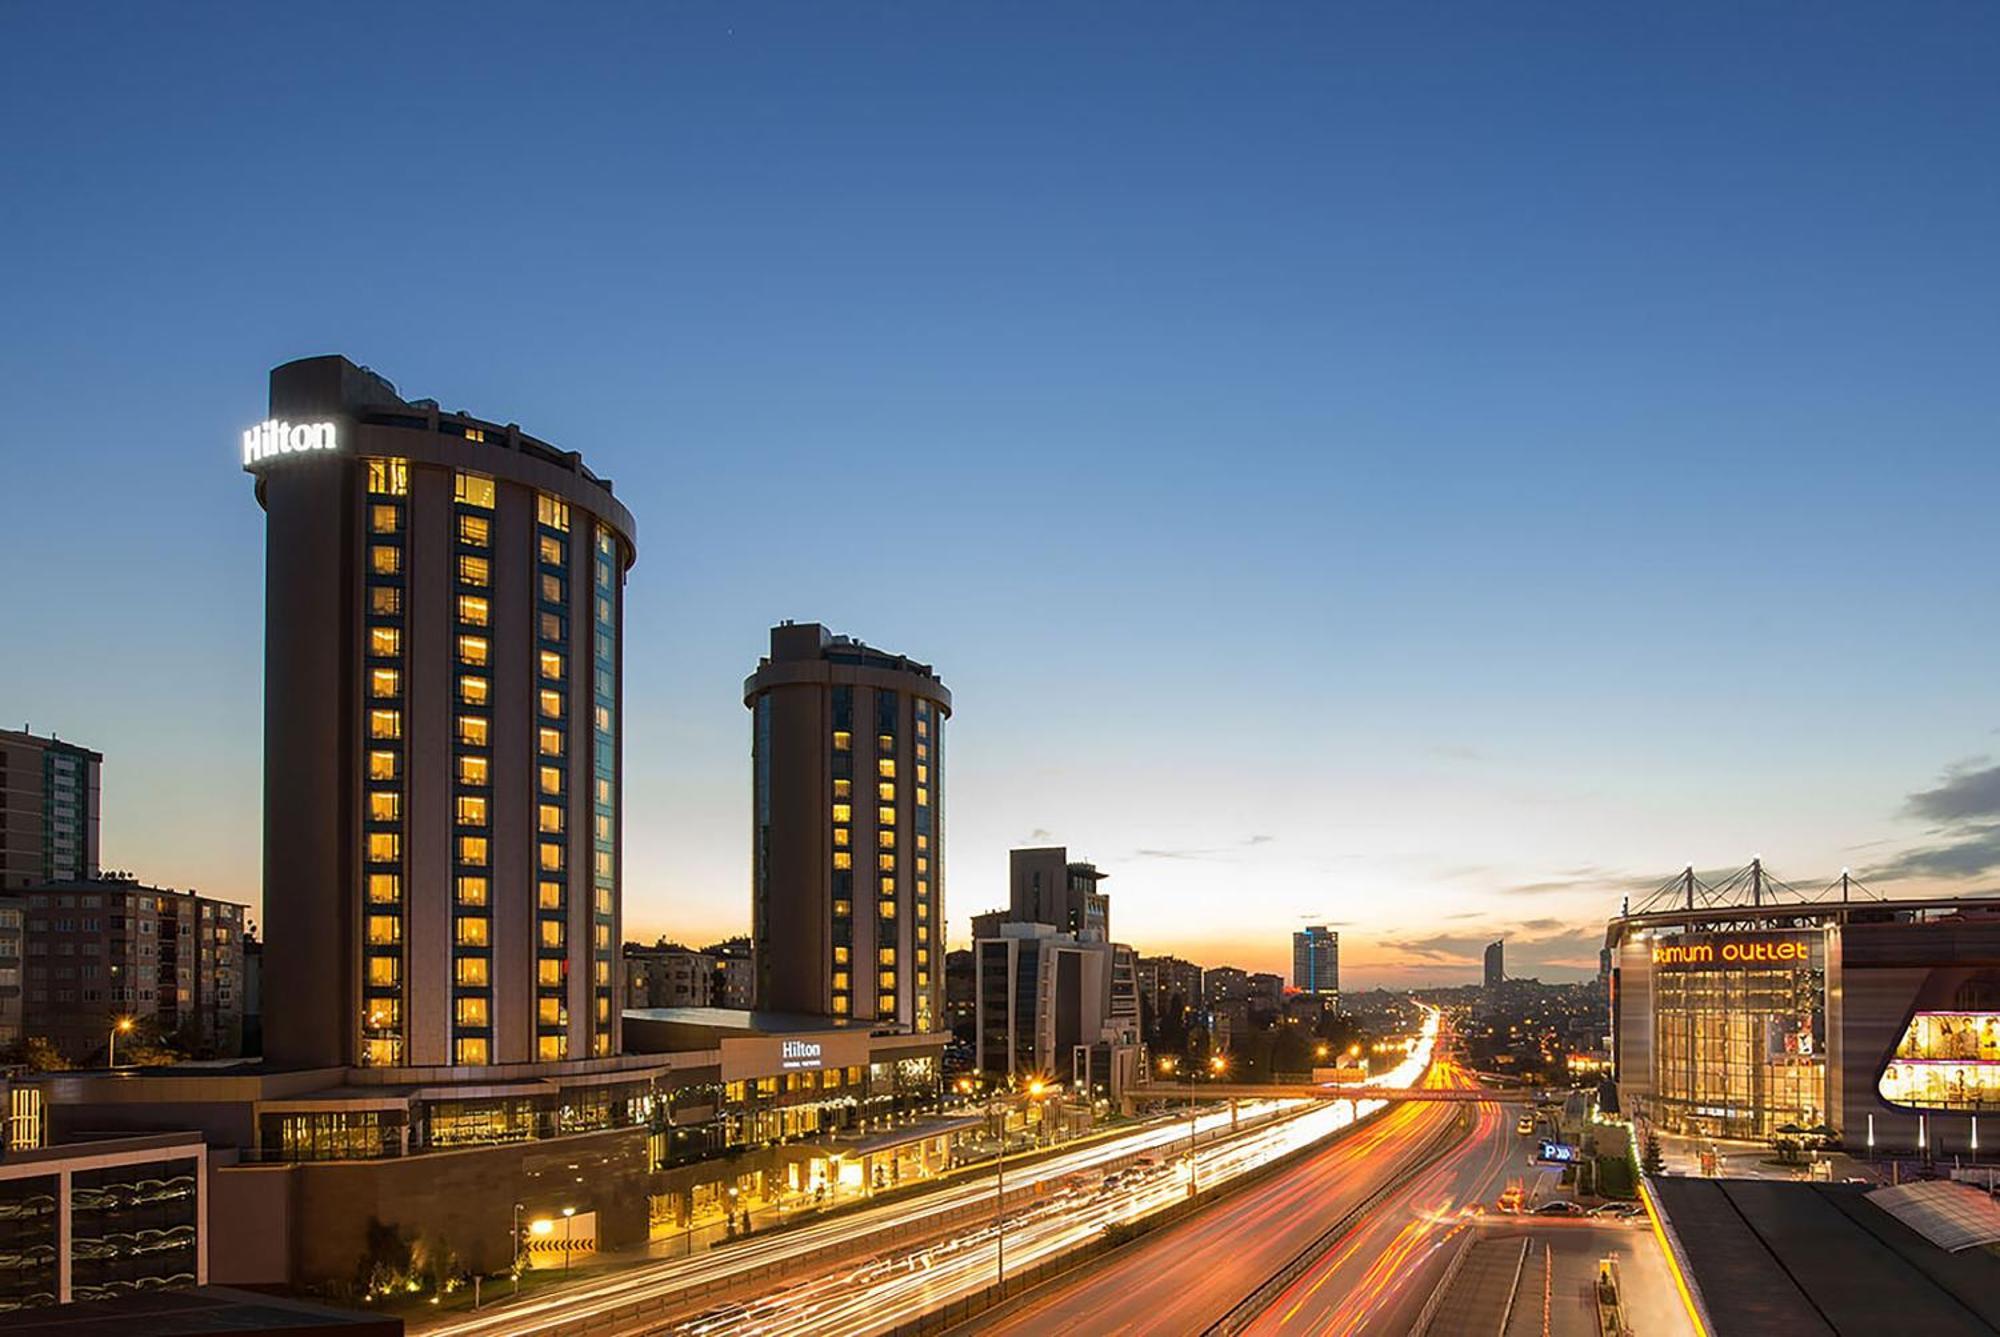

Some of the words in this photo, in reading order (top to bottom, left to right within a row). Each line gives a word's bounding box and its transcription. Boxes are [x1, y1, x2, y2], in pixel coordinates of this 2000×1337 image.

[243, 418, 337, 465] Hilton
[1722, 943, 1808, 961] outlet
[783, 1040, 820, 1058] Hilton
[1545, 1145, 1556, 1158] P
